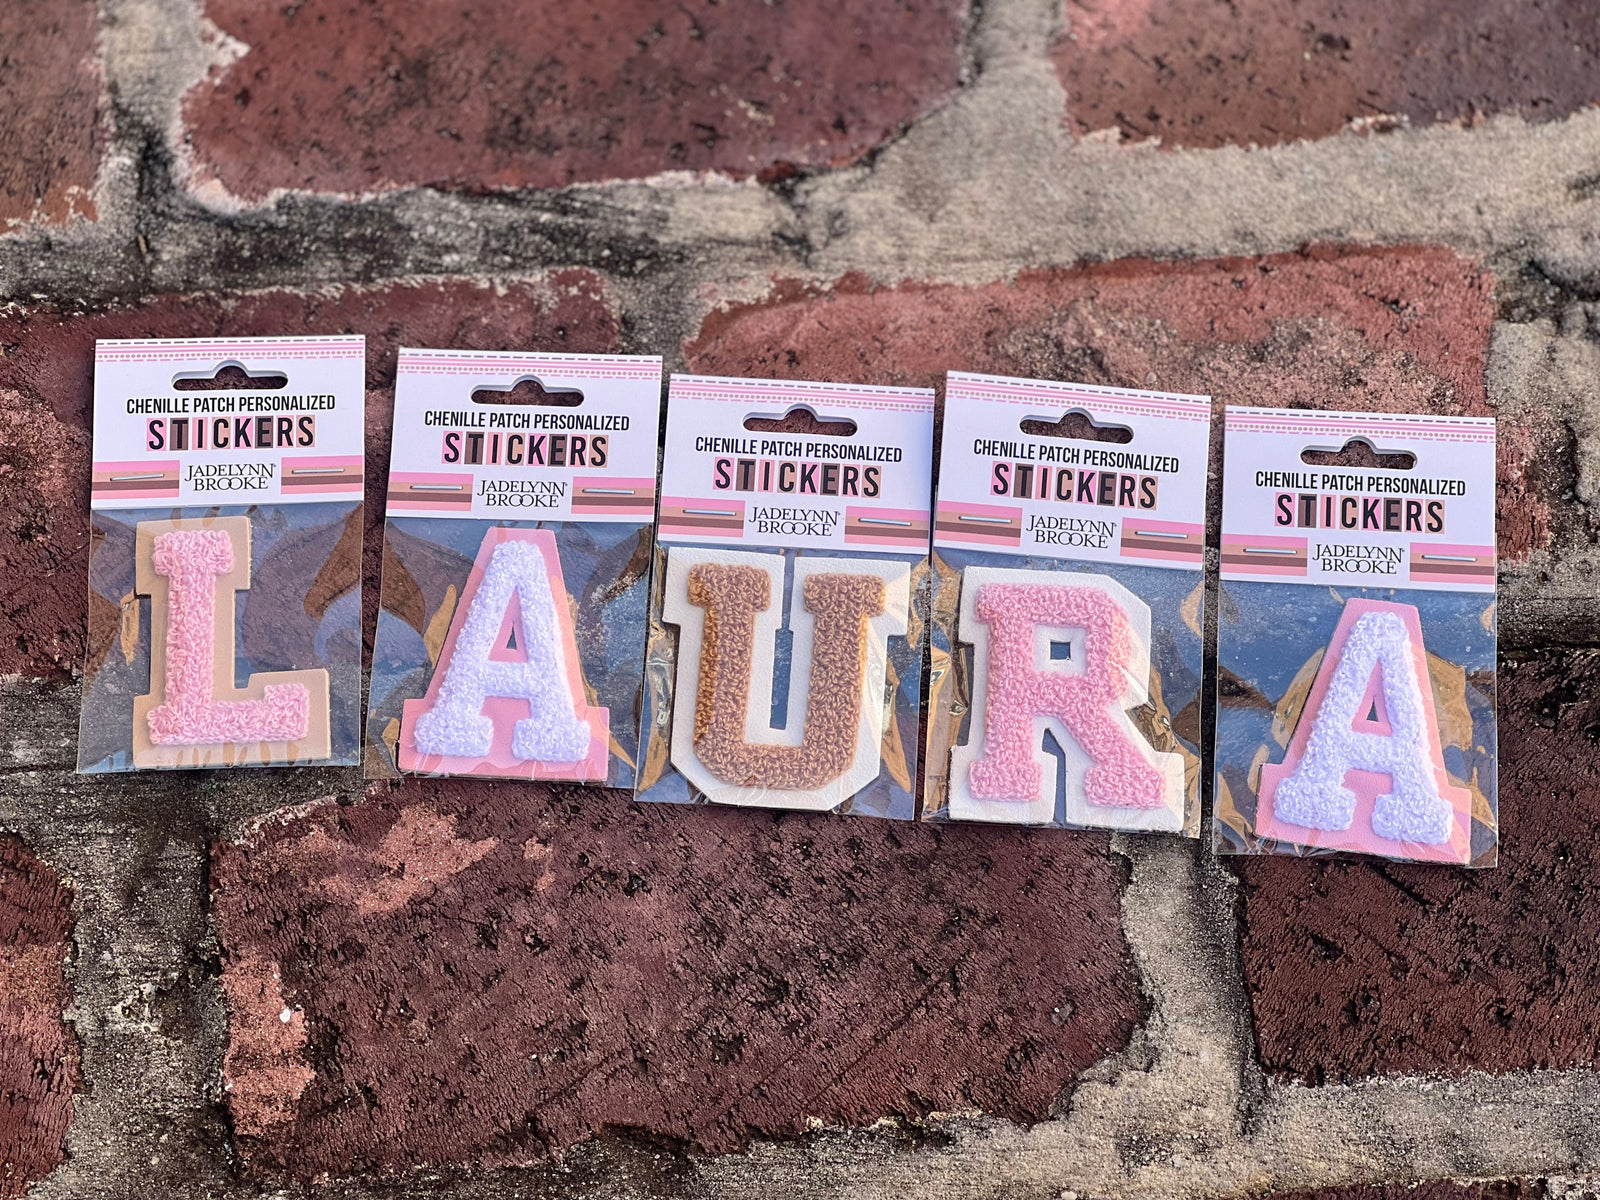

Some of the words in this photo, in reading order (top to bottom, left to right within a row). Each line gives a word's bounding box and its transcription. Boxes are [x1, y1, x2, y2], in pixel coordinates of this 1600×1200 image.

[127, 398, 190, 414] CHENILLE
[193, 396, 235, 413] PATCH
[239, 395, 336, 412] PERSONALIZED
[149, 416, 314, 450] STICKERS
[424, 410, 486, 427] CHENILLE
[489, 412, 530, 429] PATCH
[534, 414, 630, 431] PERSONALIZED
[444, 432, 607, 467] STICKERS
[695, 437, 758, 455] CHENILLE
[761, 440, 800, 457] PATCH
[806, 442, 902, 463] PERSONALIZED
[973, 439, 1036, 460] CHENILLE
[1039, 445, 1080, 464] PATCH
[1083, 450, 1179, 473] PERSONALIZED
[185, 463, 275, 481] JADELYNN
[194, 477, 269, 491] BROOKE
[715, 459, 880, 497] STICKERS
[1256, 471, 1318, 489] CHENILLE
[1321, 474, 1363, 491] PATCH
[1367, 476, 1466, 496] PERSONALIZED
[477, 480, 566, 497] JADELYNN
[993, 463, 1156, 509] STICKERS
[485, 495, 559, 508] BROOKE
[1277, 494, 1443, 533] STICKERS
[749, 506, 839, 526] JADELYNN
[1025, 515, 1116, 538] JADELYNN
[758, 521, 832, 537] BROOKE
[1034, 532, 1109, 549] BROOKE
[1312, 544, 1403, 564] JADELYNN
[1321, 559, 1397, 575] BROOKE
[146, 529, 310, 745] L
[413, 539, 591, 761] A
[686, 560, 886, 792] U
[966, 581, 1168, 811] R
[1271, 610, 1454, 845] A
